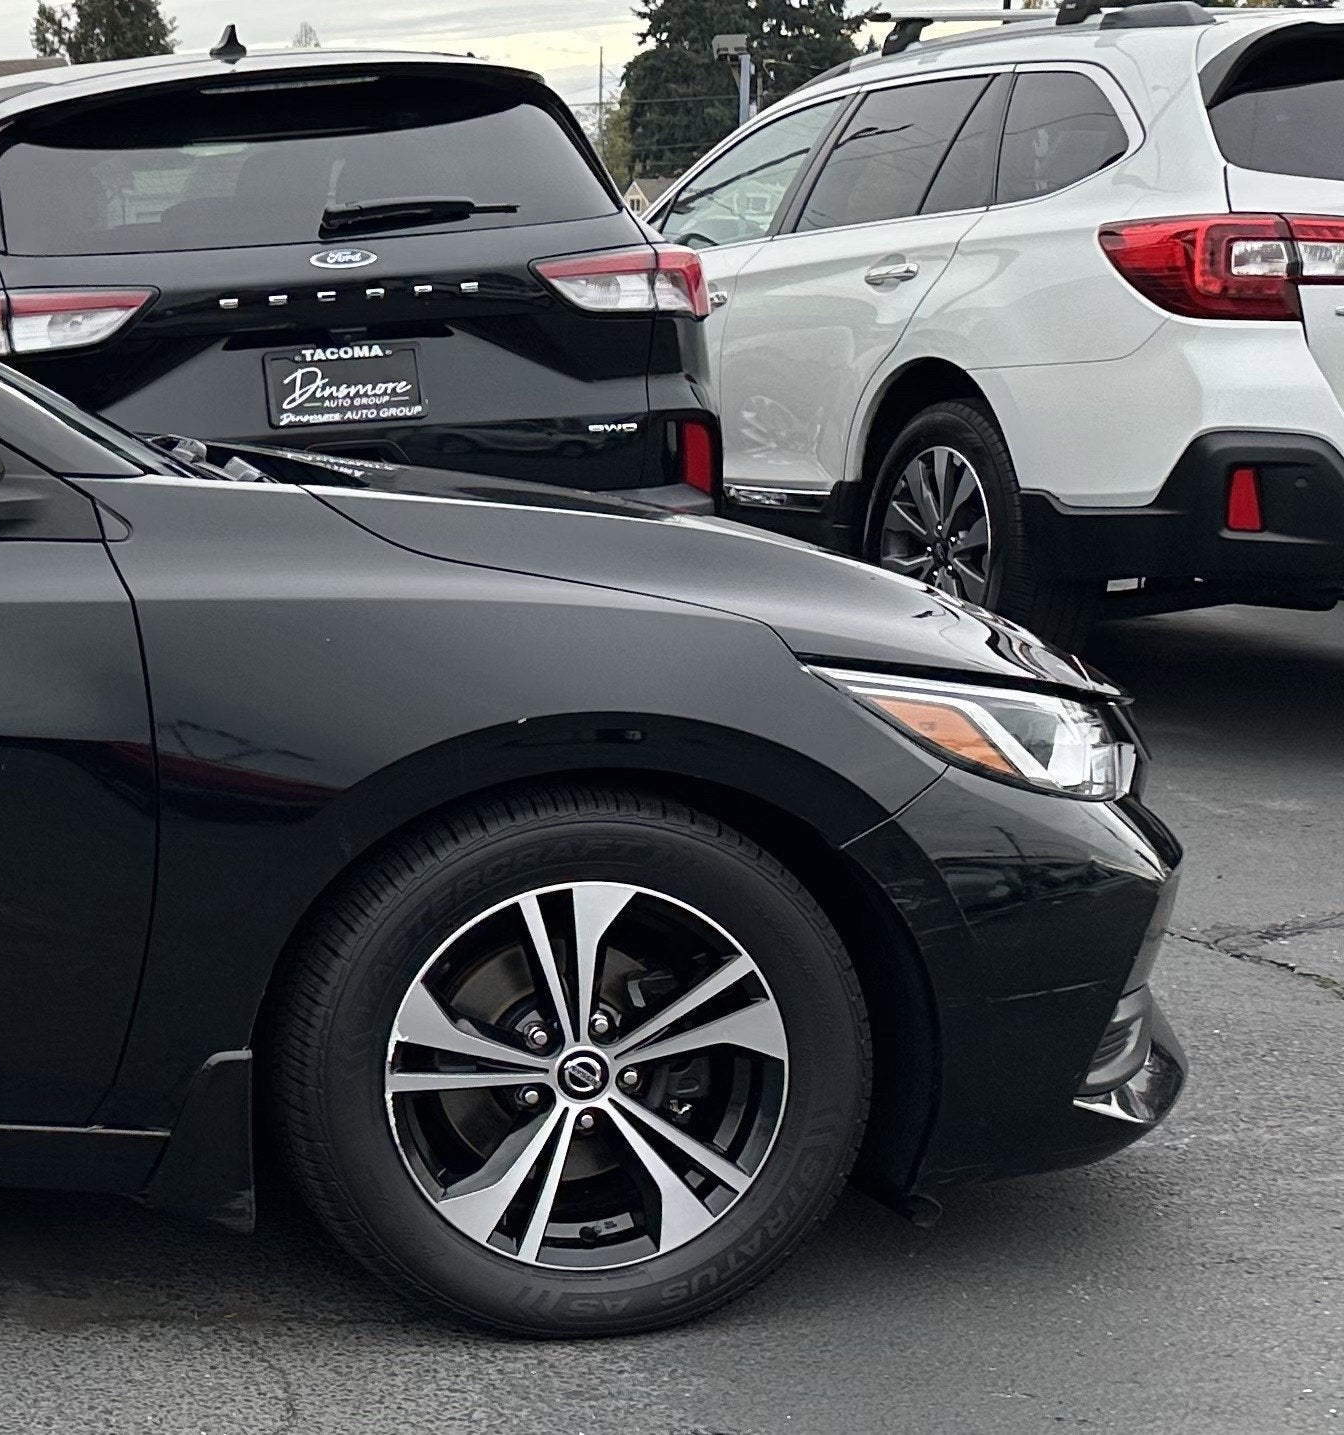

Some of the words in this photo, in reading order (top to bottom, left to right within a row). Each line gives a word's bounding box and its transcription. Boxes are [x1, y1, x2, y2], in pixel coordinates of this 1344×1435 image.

[326, 250, 362, 263] Ford
[301, 345, 384, 362] TACOMA
[282, 366, 412, 409] Dinsmore
[323, 399, 351, 408] AUTO
[353, 396, 390, 407] GROUP
[343, 409, 377, 420] AUTO
[379, 405, 423, 418] GROUP
